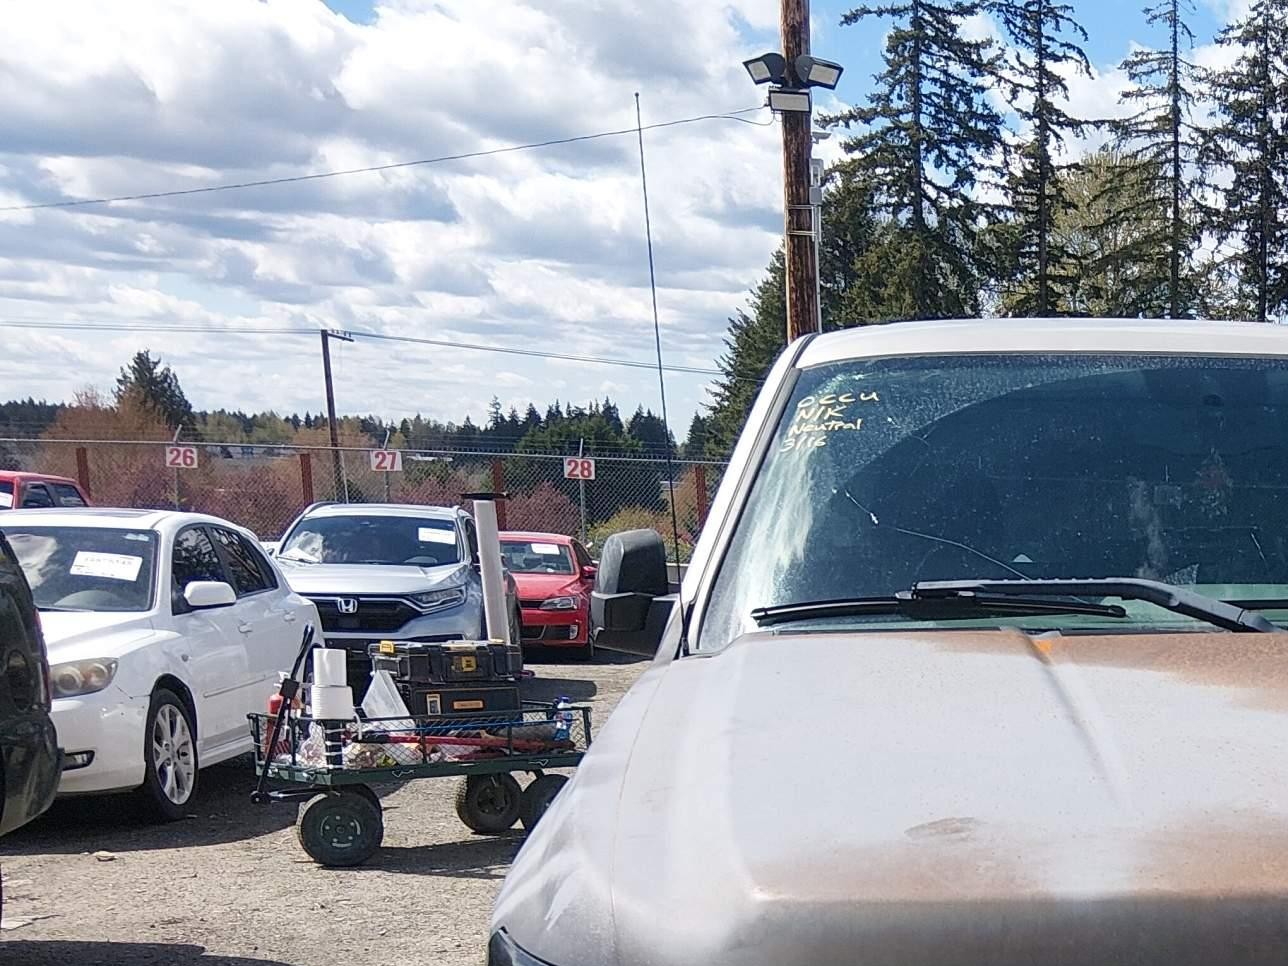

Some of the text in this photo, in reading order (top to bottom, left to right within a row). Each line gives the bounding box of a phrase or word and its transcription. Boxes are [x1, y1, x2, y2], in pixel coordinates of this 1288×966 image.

[169, 448, 195, 466] 26
[375, 451, 397, 470] 27
[567, 459, 592, 478] 28
